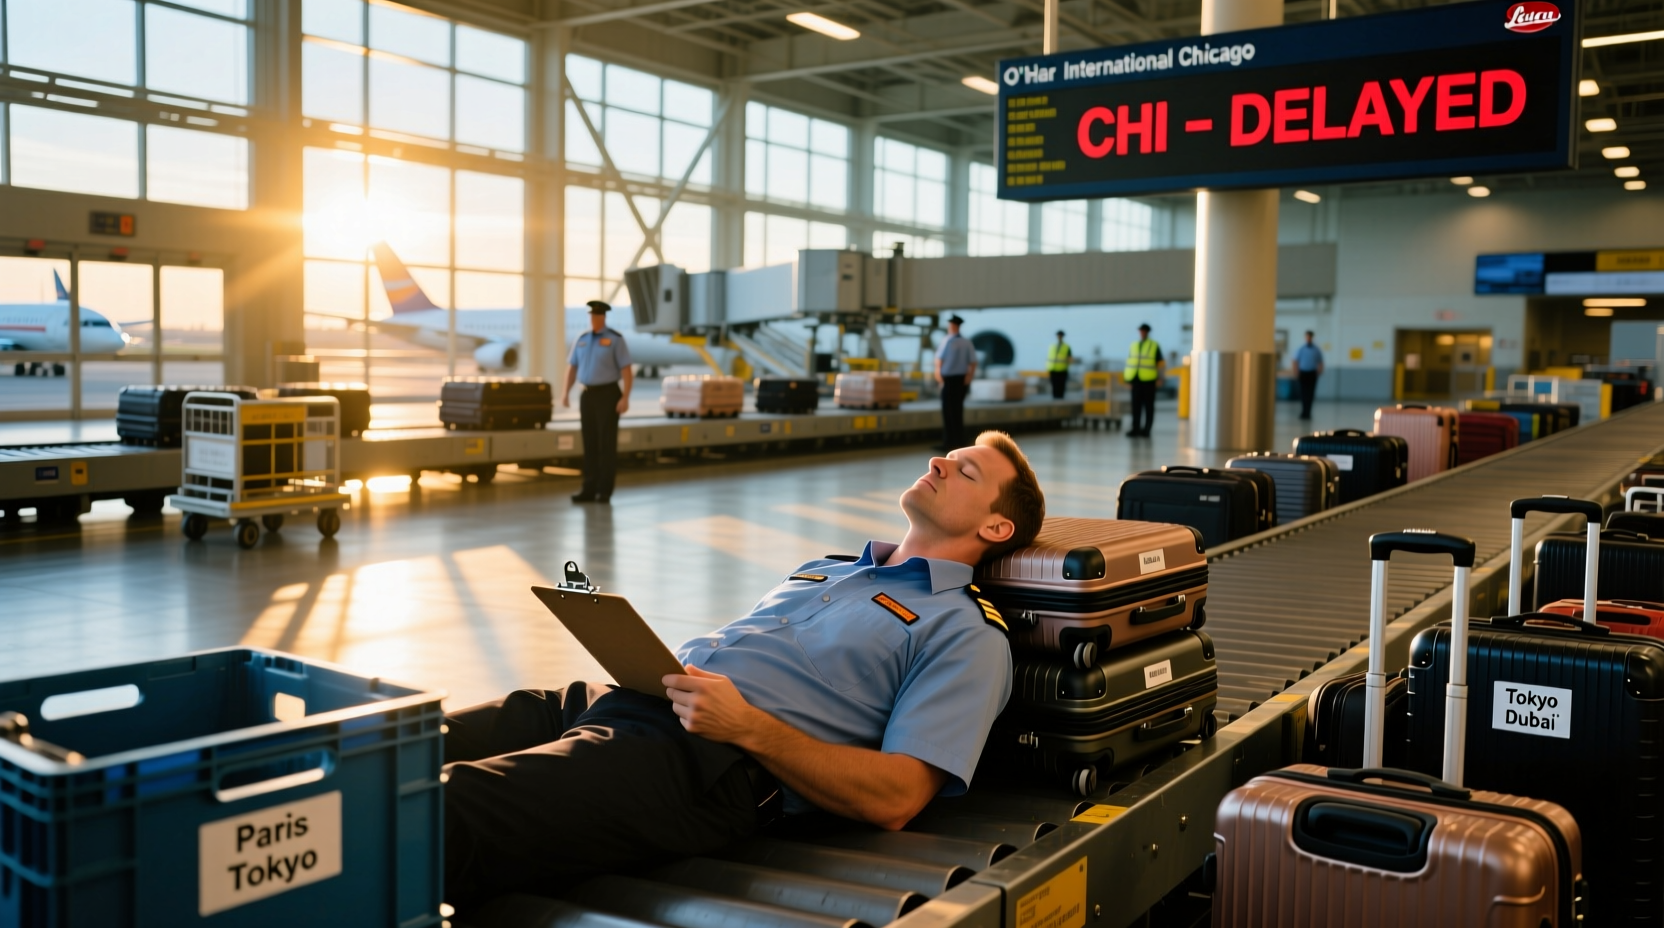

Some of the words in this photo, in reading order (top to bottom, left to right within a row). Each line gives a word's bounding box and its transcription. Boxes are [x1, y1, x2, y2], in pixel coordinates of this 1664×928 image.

[1003, 64, 1057, 86] O'Har
[1063, 48, 1173, 81] International
[1178, 43, 1256, 67] Chicago
[1076, 101, 1168, 159] CHI
[1184, 119, 1213, 132] -
[1229, 69, 1527, 147] DELAYED
[1504, 687, 1558, 711] Tokyo
[236, 812, 309, 853] Paris
[227, 849, 318, 891] Tokyo
